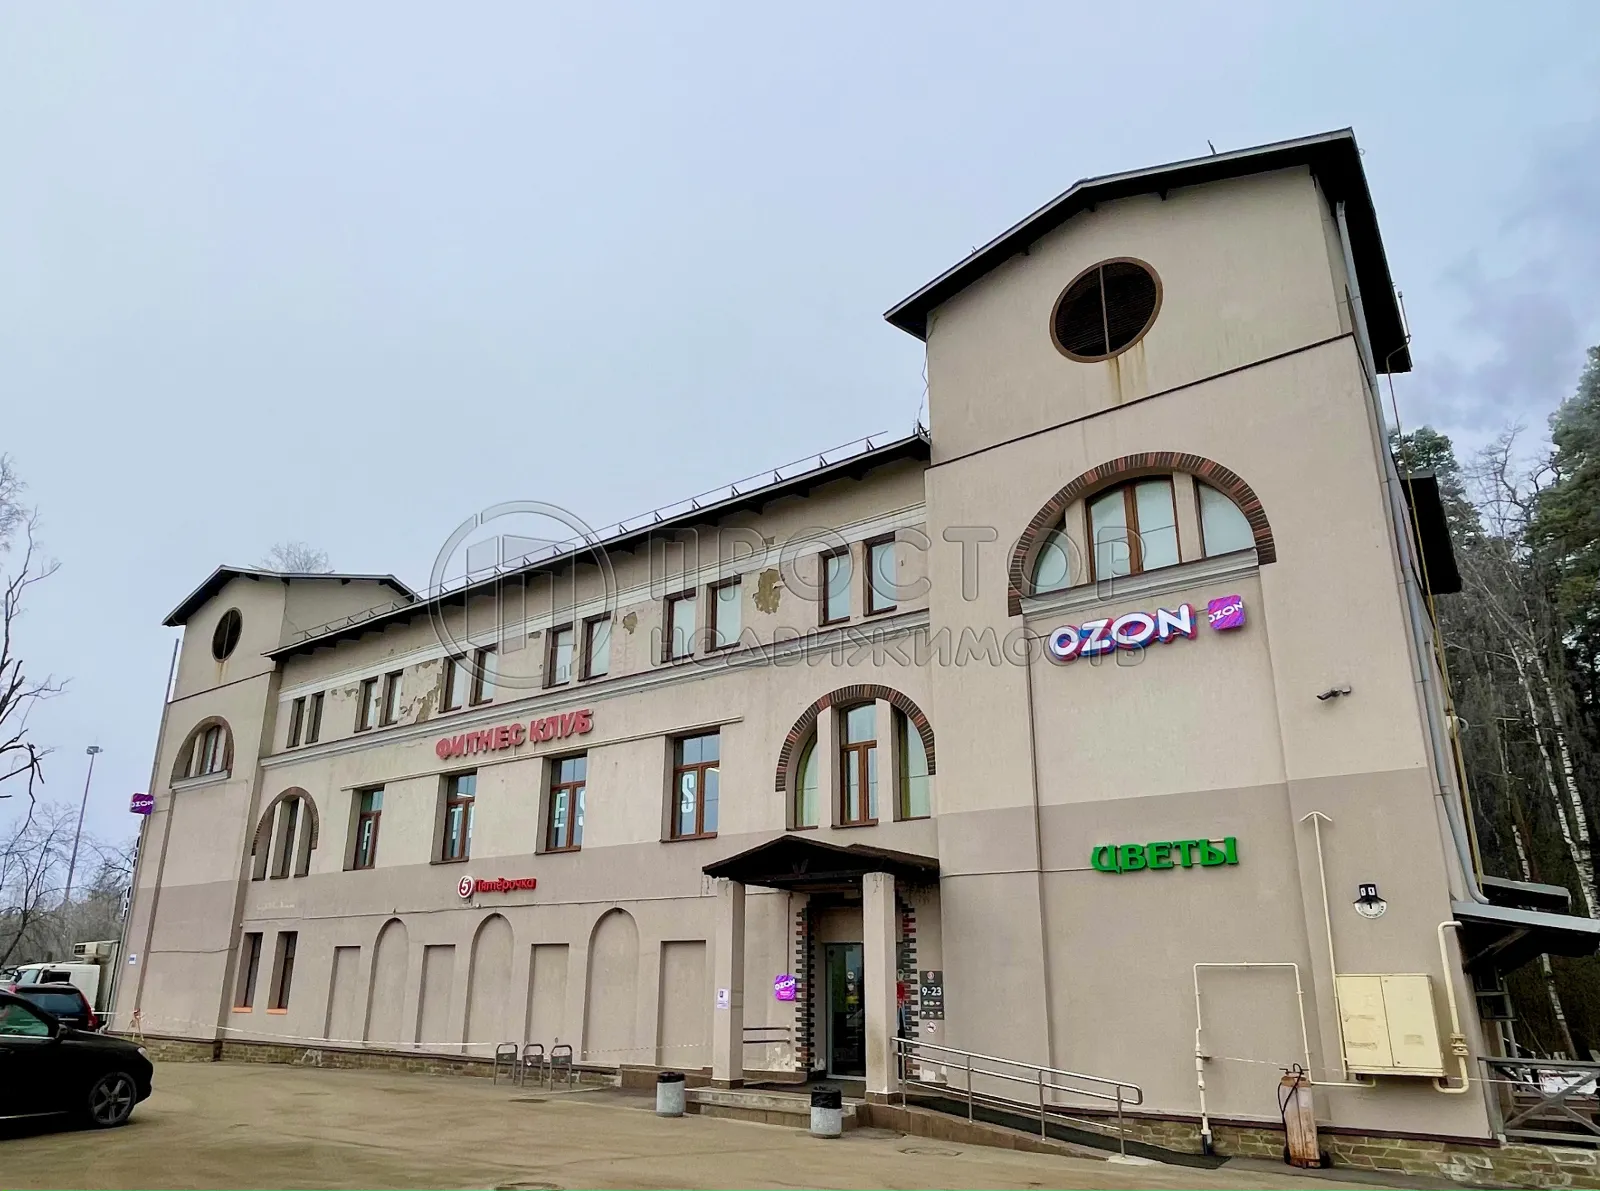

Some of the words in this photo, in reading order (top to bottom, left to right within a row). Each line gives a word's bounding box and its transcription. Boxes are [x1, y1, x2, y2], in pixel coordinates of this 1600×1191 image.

[1049, 604, 1196, 660] OZON
[435, 723, 525, 760] ФИТНЕС
[529, 709, 594, 743] КЛУБ
[1091, 837, 1239, 874] ЦВЕТЫ
[775, 978, 795, 991] OZON
[921, 986, 942, 996] 9-23
